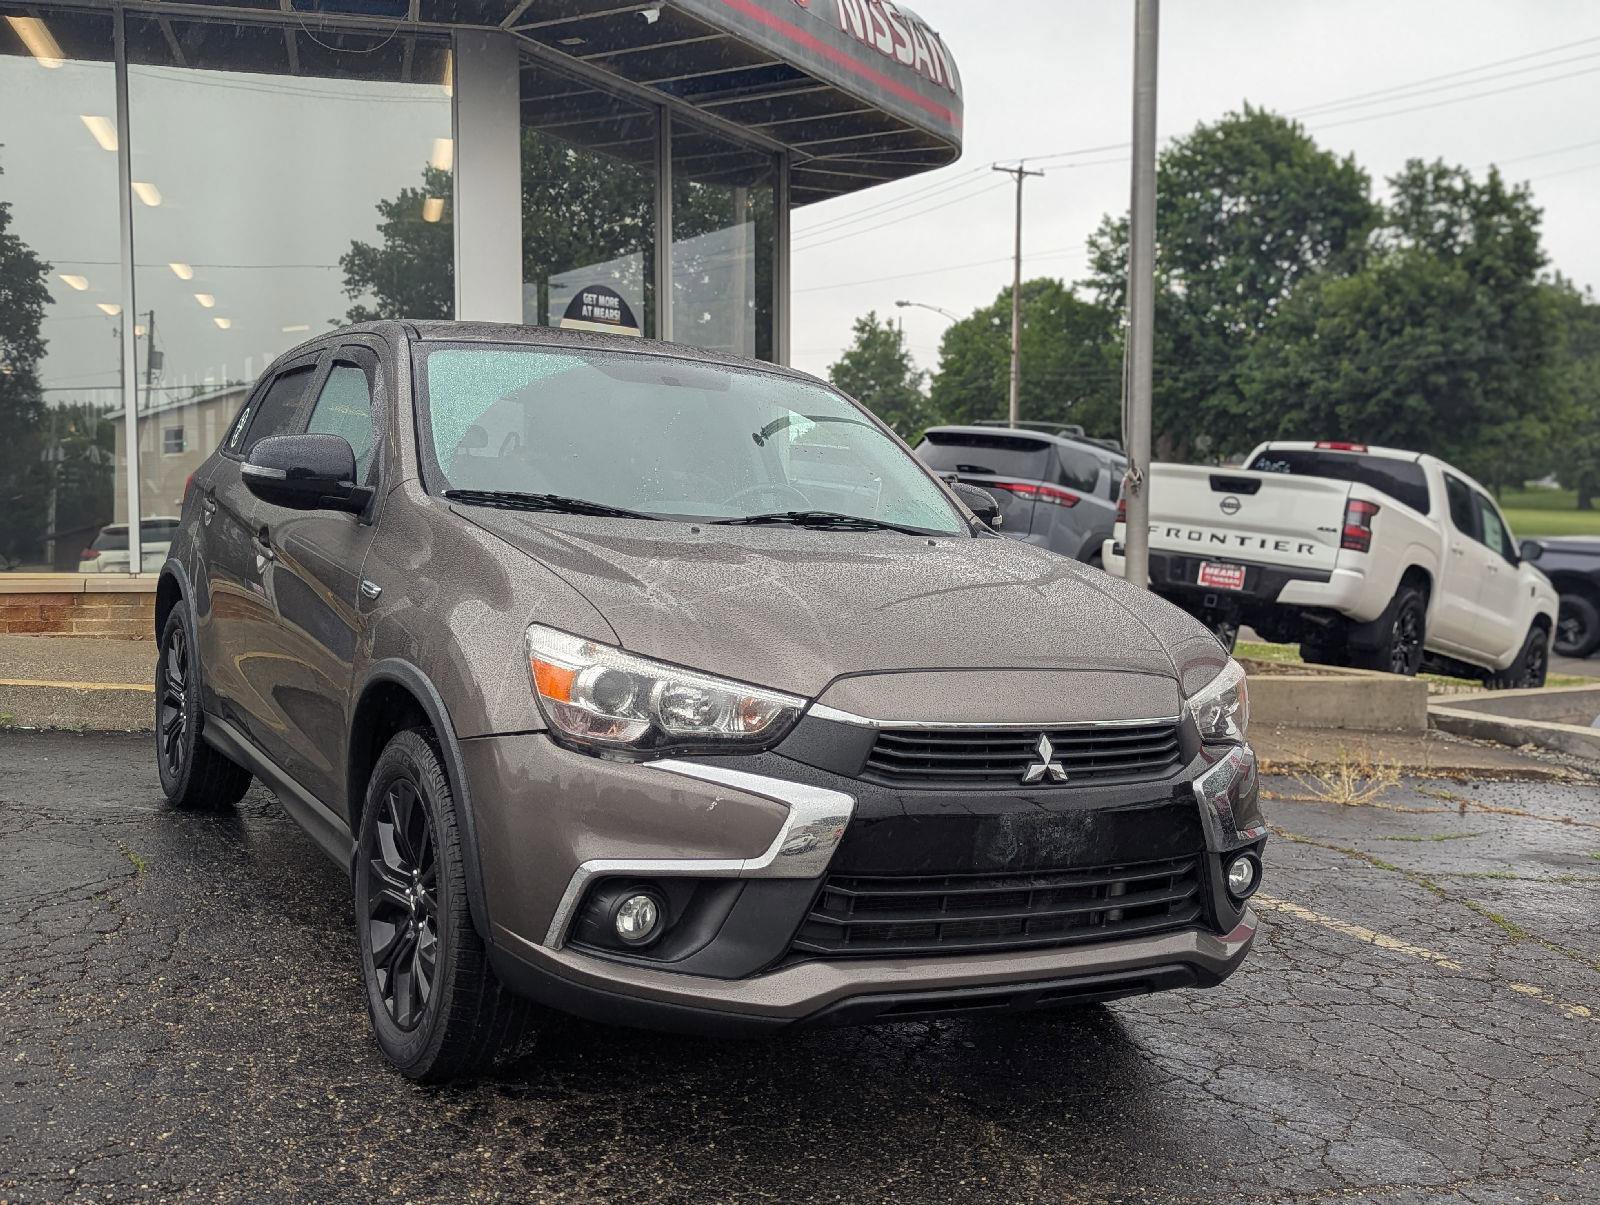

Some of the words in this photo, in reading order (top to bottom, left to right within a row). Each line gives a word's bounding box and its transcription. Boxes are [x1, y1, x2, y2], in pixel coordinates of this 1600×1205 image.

[837, 0, 957, 95] NISSAN
[581, 305, 593, 316] AT
[583, 293, 598, 304] GET
[599, 295, 620, 308] MORE
[1148, 526, 1314, 555] FRONTIER
